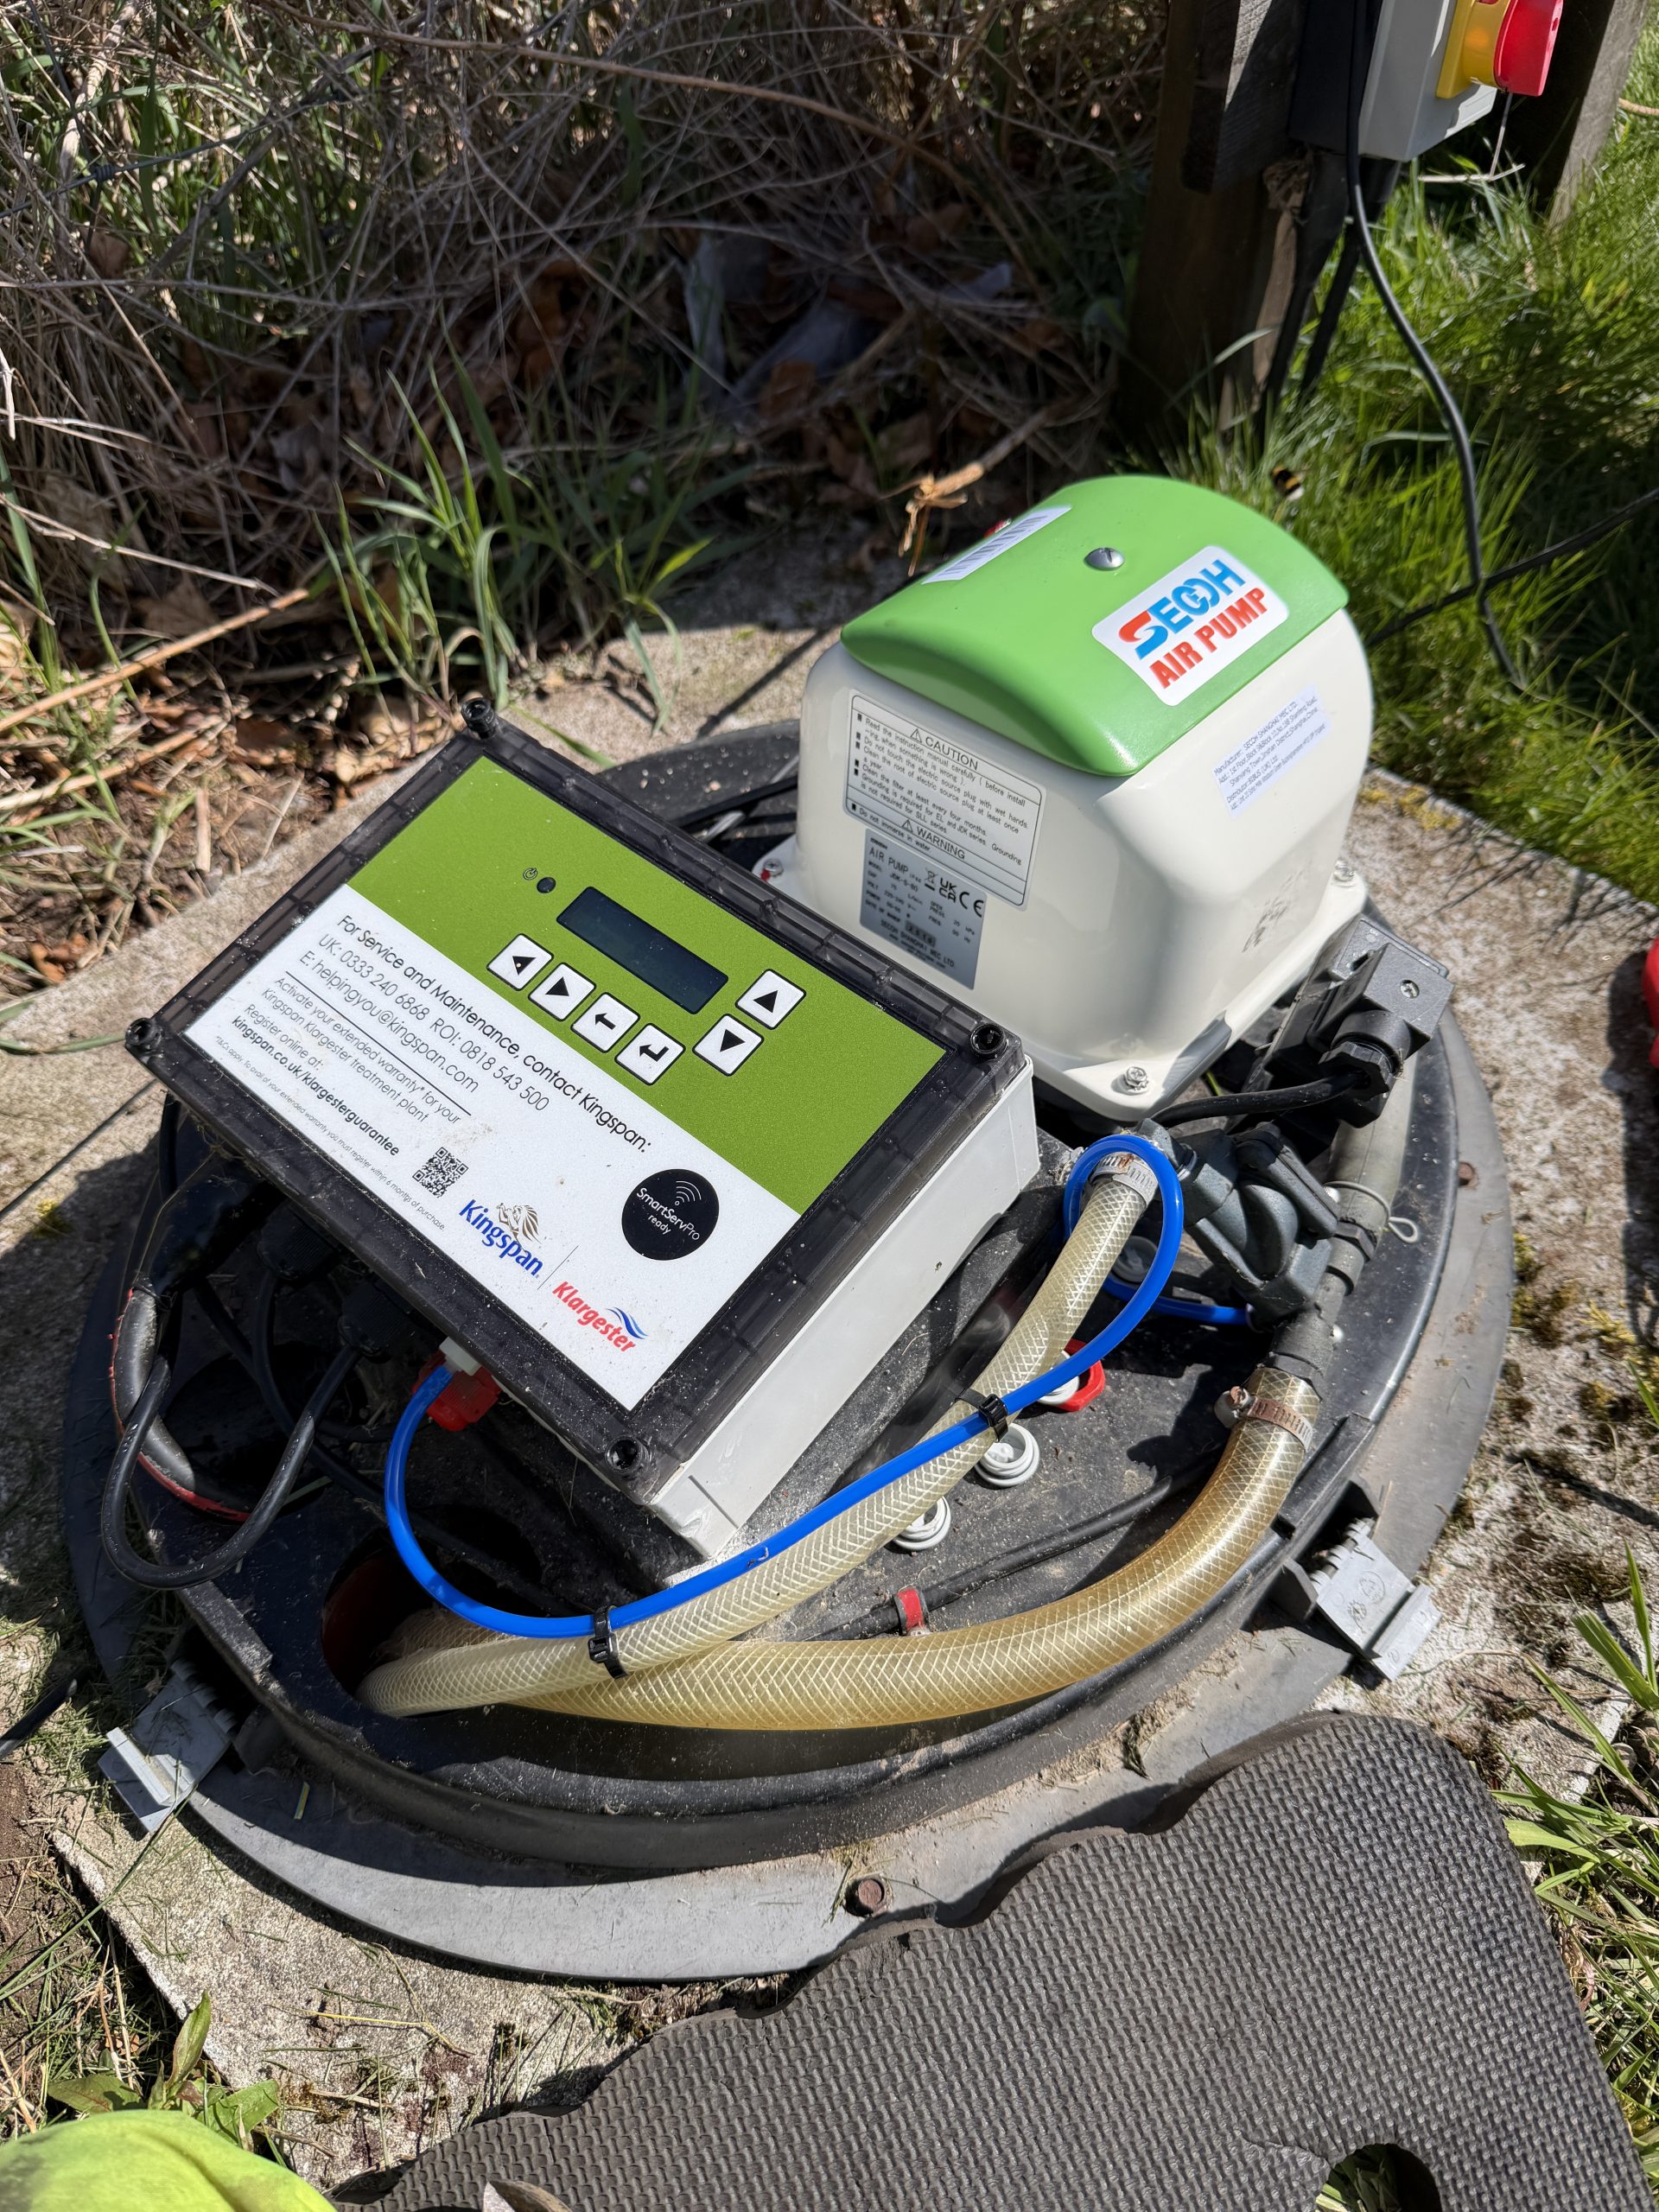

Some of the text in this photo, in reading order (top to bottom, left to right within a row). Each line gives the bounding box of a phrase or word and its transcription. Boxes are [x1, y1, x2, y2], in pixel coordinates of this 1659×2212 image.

[1149, 588, 1268, 689] AIR PUMP
[863, 746, 1019, 835] Clean the root of electric source plug at least once
[864, 735, 1028, 829] Do not touch the electric source plug with wet hands.
[865, 717, 880, 732] Read
[882, 728, 893, 738] the
[894, 733, 925, 755] instruction
[926, 752, 949, 767] manual
[950, 764, 976, 782] carefully
[985, 780, 1005, 797] before
[1007, 791, 1026, 807] install
[881, 738, 896, 750] when
[899, 747, 929, 768] something
[939, 767, 957, 783] wrong
[925, 736, 978, 771] CAUTION
[859, 806, 868, 817] Do
[869, 815, 880, 824] not
[881, 822, 905, 838] immerse
[906, 834, 912, 842] in
[861, 772, 890, 795] Grounding
[899, 795, 923, 811] required
[925, 807, 933, 817] for
[935, 812, 944, 823] EL
[946, 820, 957, 830] and
[957, 825, 969, 836] JDK
[991, 842, 1022, 866] Grounding
[862, 763, 878, 778] Clean
[880, 773, 890, 784] the
[892, 779, 905, 791] filter
[915, 792, 930, 805] least
[931, 803, 947, 816] every
[950, 810, 962, 822] four
[963, 819, 987, 836] months.
[868, 786, 878, 797] not
[880, 793, 903, 810] required
[905, 805, 913, 814] for
[915, 810, 927, 823] SLL
[868, 847, 885, 862] AIR
[887, 856, 909, 874] PUMP
[915, 826, 965, 860] WARNING
[939, 877, 957, 894] UK
[958, 891, 984, 918] CE
[244, 1003, 325, 1071] Register online at:
[261, 988, 429, 1122] Kingspan Klargester treatment plant
[274, 977, 314, 1009] Activate
[310, 1006, 335, 1026] your
[332, 1023, 381, 1061] extended
[421, 1090, 440, 1107] for
[434, 1103, 461, 1124] your
[299, 950, 479, 1093] E: helpingyou@kingspan.com
[318, 933, 550, 1111] UK: 0333 240 6868 ROI: 0818 543 500
[337, 914, 652, 1153] For Service and Maintenance, contact Kingspan:
[232, 1015, 399, 1156] kingspan.co.uk/klargesterguarantee
[267, 1081, 282, 1093] your
[279, 1091, 306, 1114] extended
[304, 1111, 329, 1133] warranty
[326, 1130, 340, 1141] you
[337, 1139, 353, 1153] must
[350, 1149, 372, 1168] register
[370, 1166, 387, 1182] within
[390, 1183, 413, 1203] months
[416, 1205, 447, 1231] purchase.
[460, 1199, 543, 1276] Kingspan
[636, 1187, 700, 1241] SmartServPro
[647, 1214, 671, 1235] ready
[552, 1281, 637, 1351] Klargester
